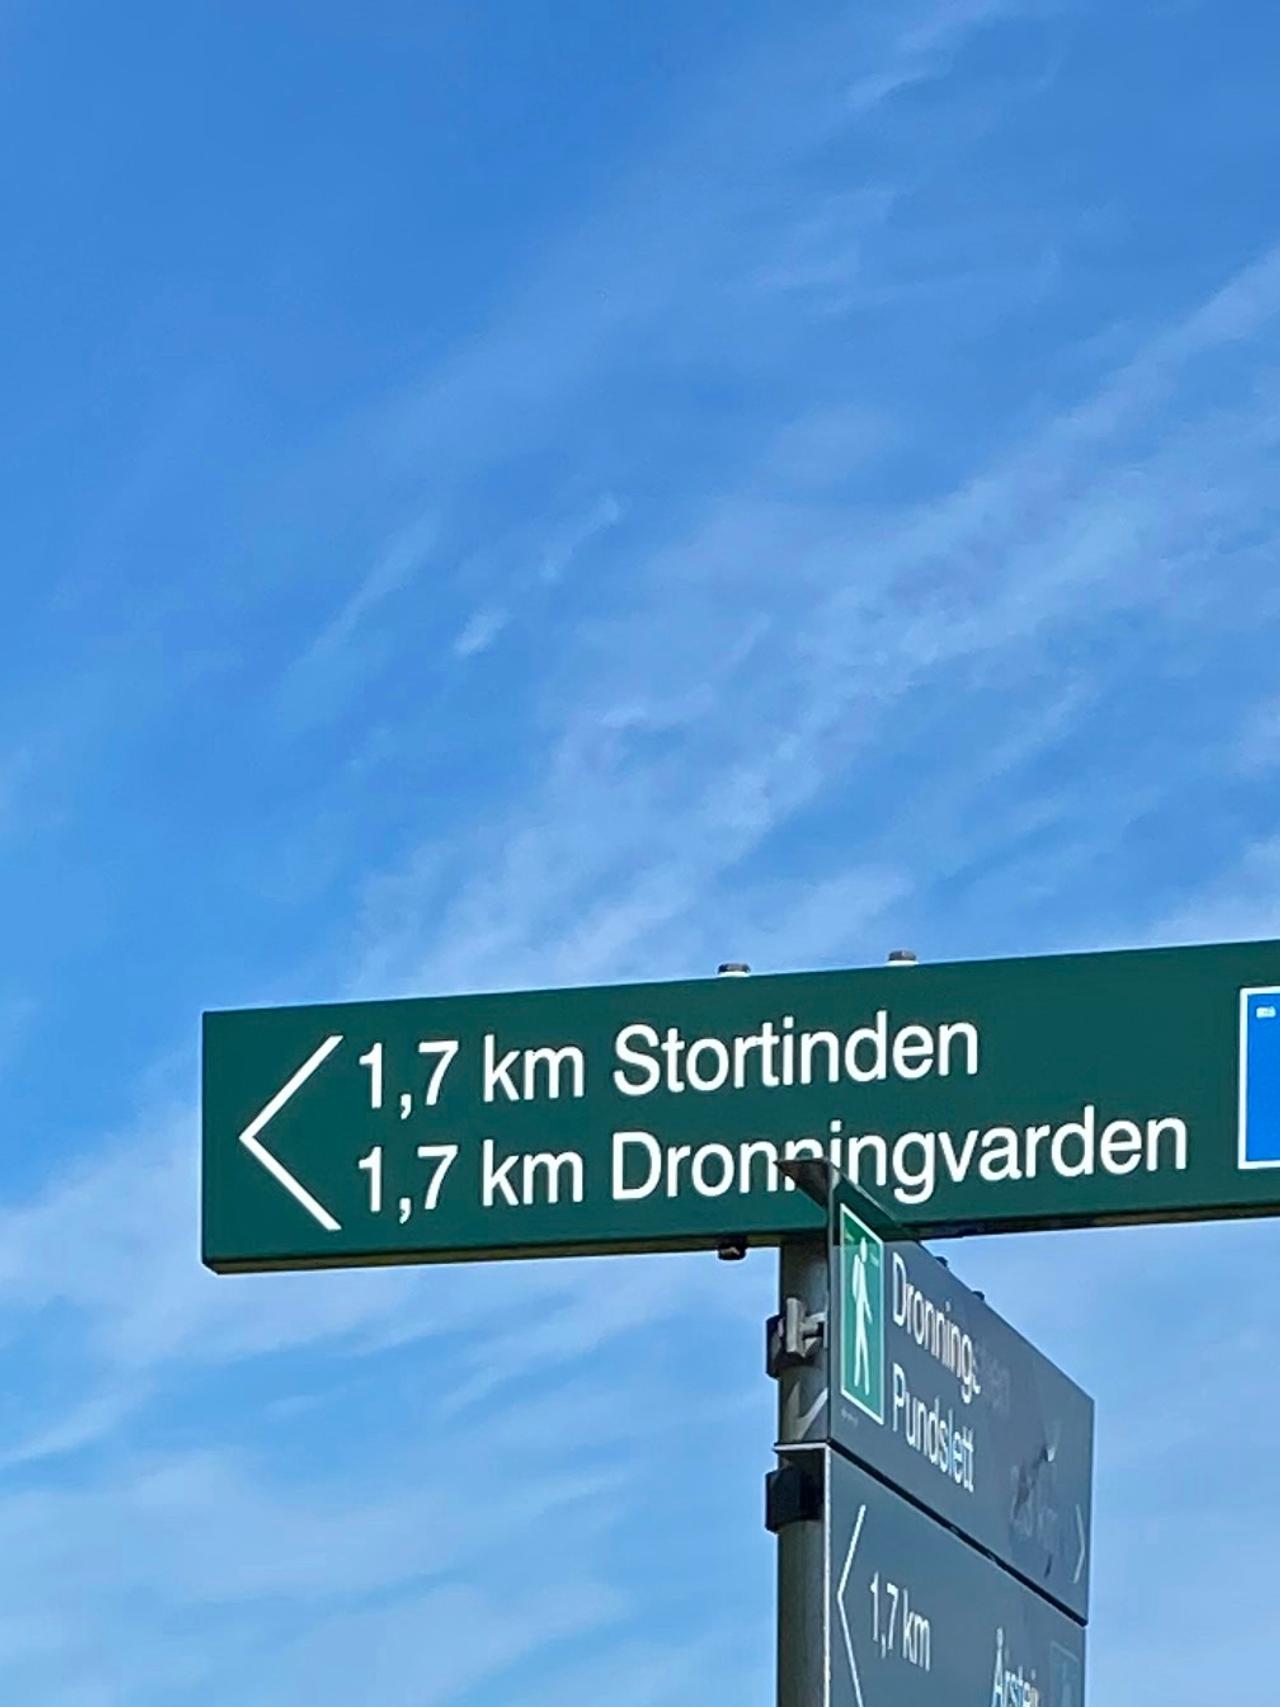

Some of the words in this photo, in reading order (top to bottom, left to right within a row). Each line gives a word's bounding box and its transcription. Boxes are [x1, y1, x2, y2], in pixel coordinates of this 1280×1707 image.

[358, 1039, 460, 1121] 1,7
[483, 1033, 585, 1103] km
[613, 1009, 979, 1097] Stortinden
[358, 1143, 459, 1225] 1,7
[482, 1138, 584, 1208] km
[611, 1104, 1187, 1205] Dronningvarden
[892, 1362, 975, 1493] Pundslett
[870, 1570, 899, 1659] 1,7
[902, 1588, 930, 1672] km
